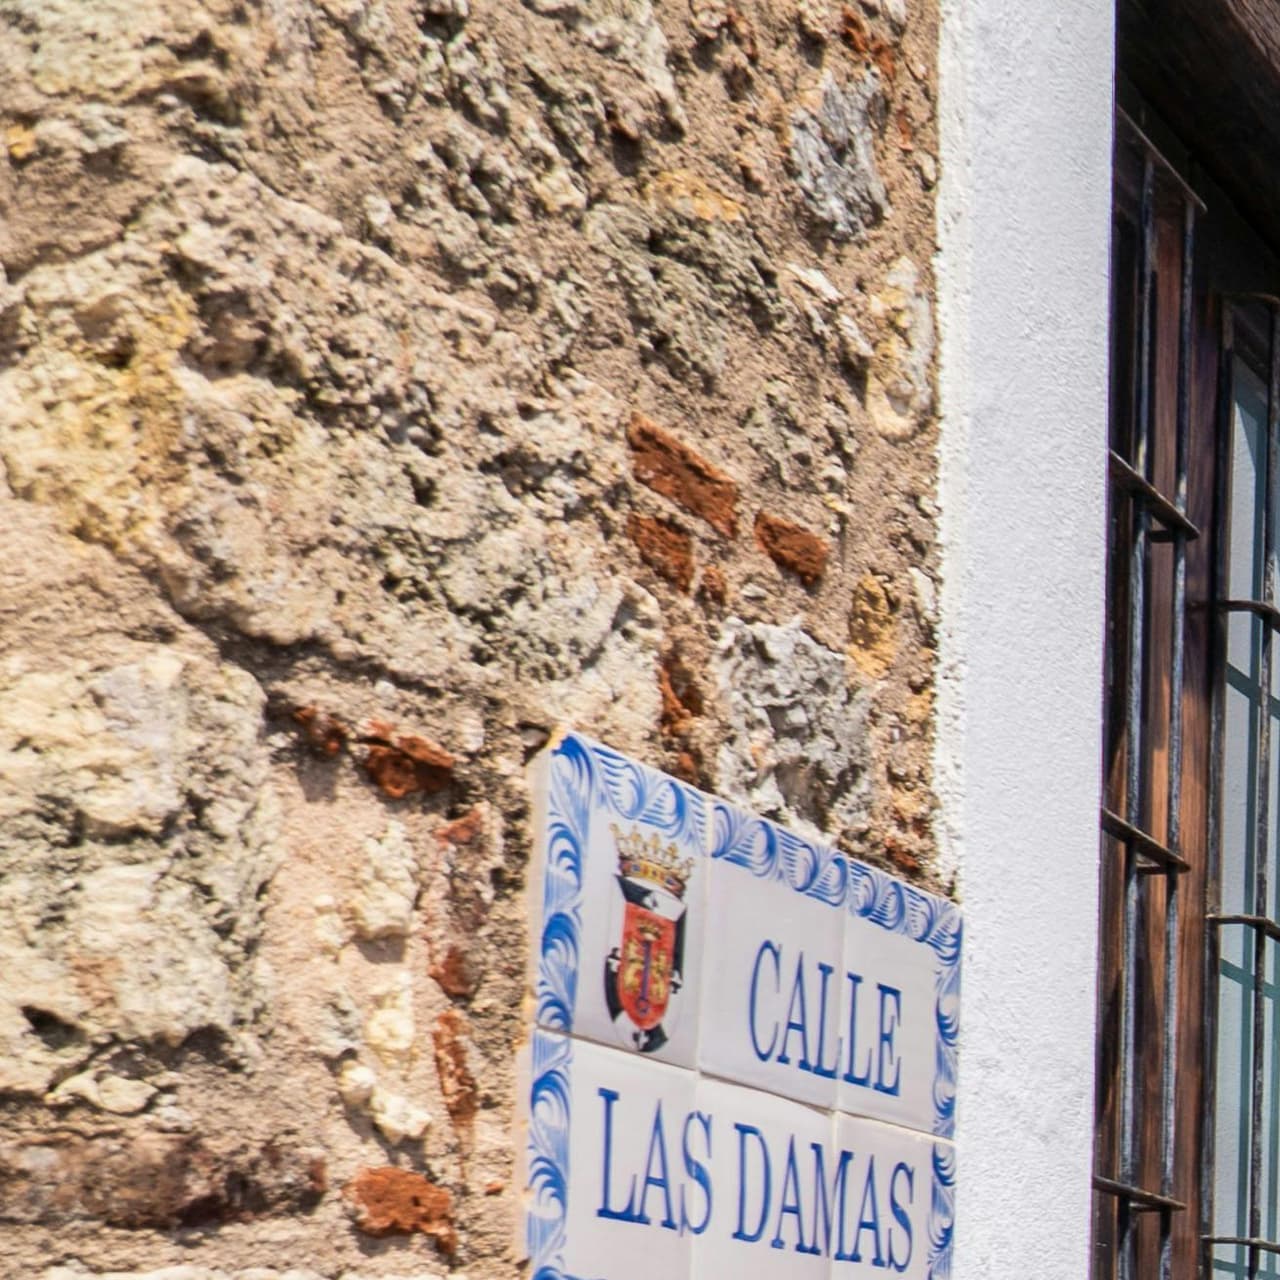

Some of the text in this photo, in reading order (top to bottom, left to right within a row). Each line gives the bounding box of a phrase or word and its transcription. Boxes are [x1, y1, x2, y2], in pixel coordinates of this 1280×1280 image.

[748, 938, 902, 1097] CALLE
[596, 1087, 917, 1273] LAS DAMAS
